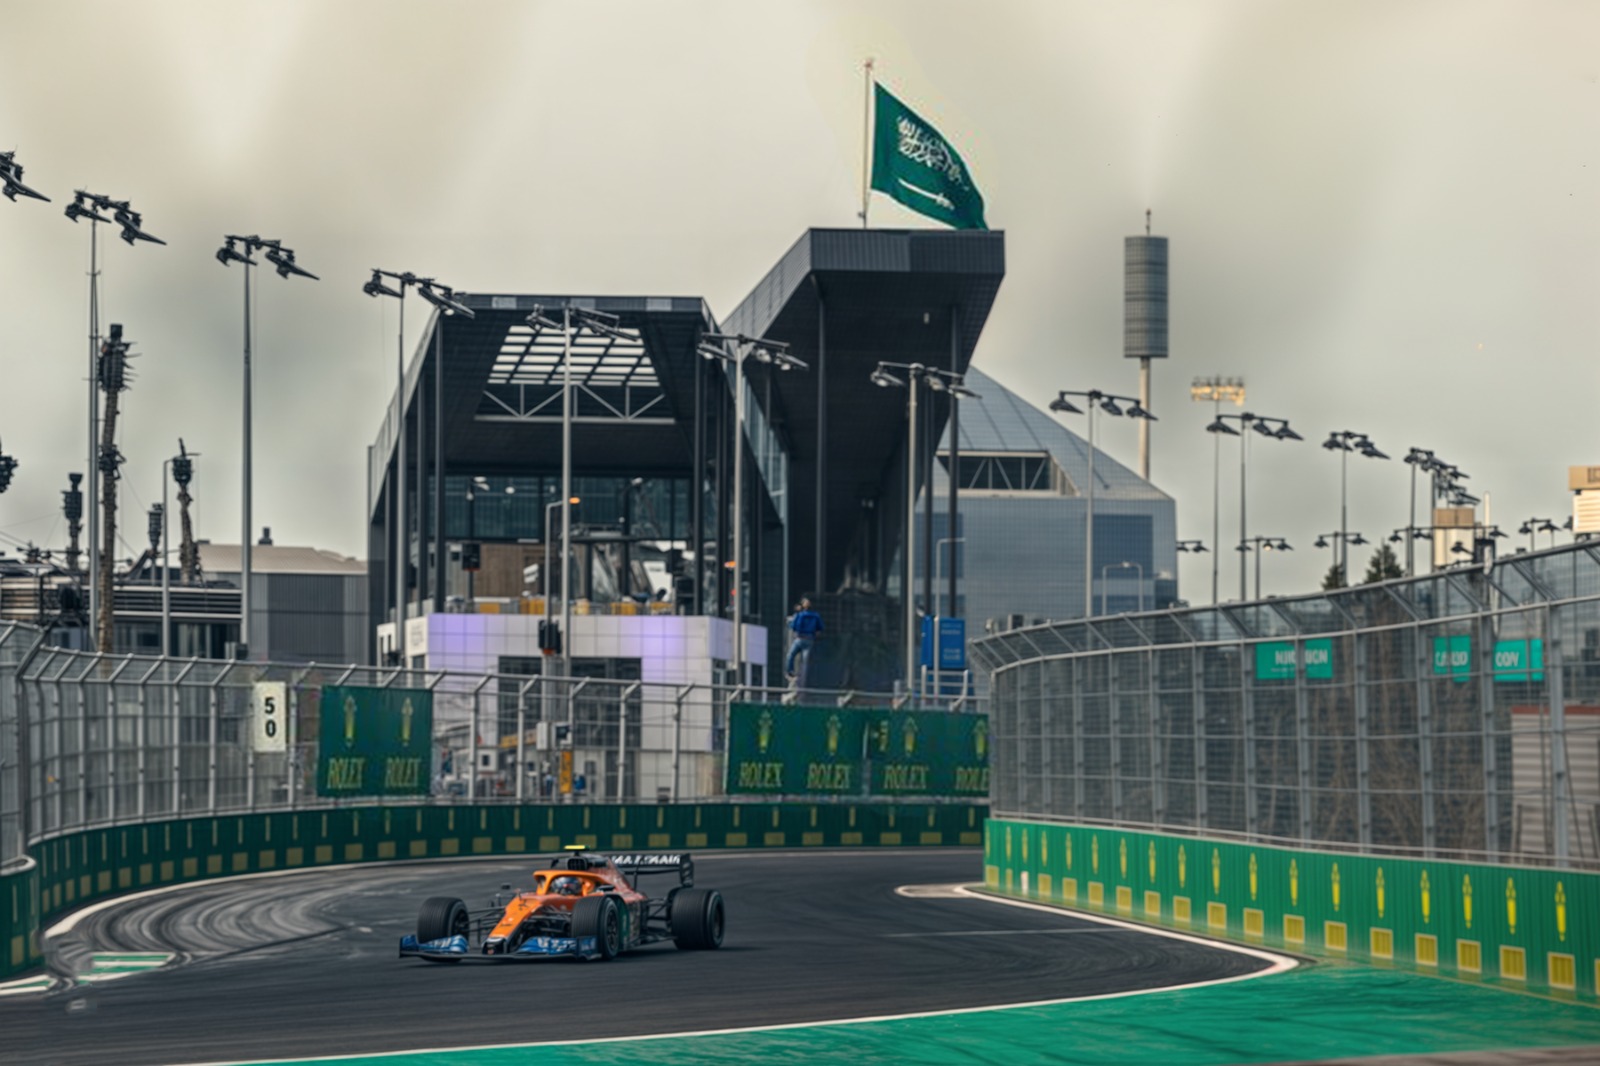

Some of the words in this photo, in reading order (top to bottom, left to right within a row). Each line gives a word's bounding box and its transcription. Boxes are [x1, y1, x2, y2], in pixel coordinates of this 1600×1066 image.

[739, 762, 783, 787] ROLEX
[807, 762, 851, 788] ROLEX
[884, 764, 929, 789] ROLEX
[955, 766, 989, 791] ROLE
